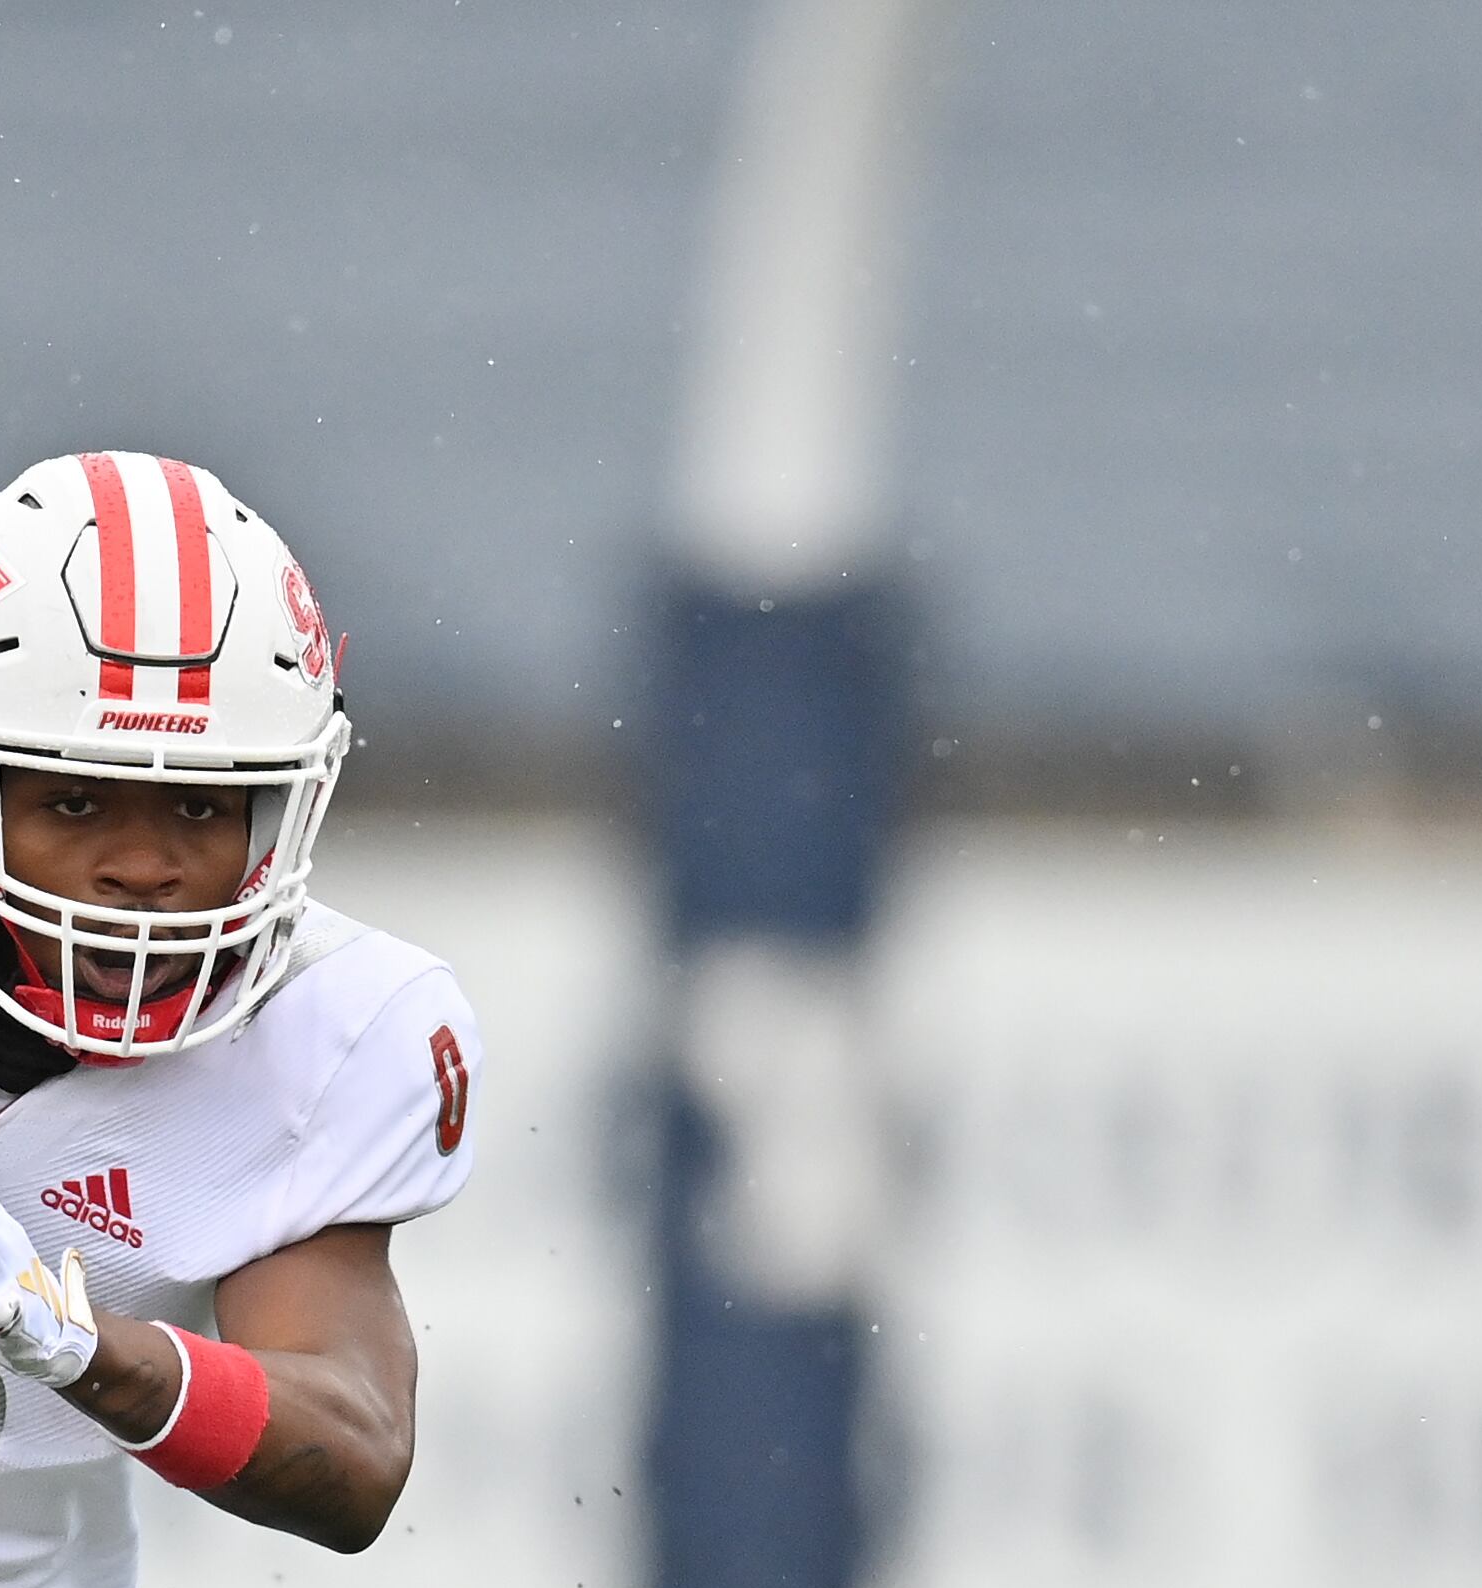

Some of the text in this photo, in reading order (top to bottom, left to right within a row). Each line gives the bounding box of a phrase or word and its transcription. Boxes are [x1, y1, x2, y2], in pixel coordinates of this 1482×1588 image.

[97, 709, 209, 735] PIONEERS
[427, 1022, 470, 1157] 0
[40, 1188, 144, 1250] adidas
